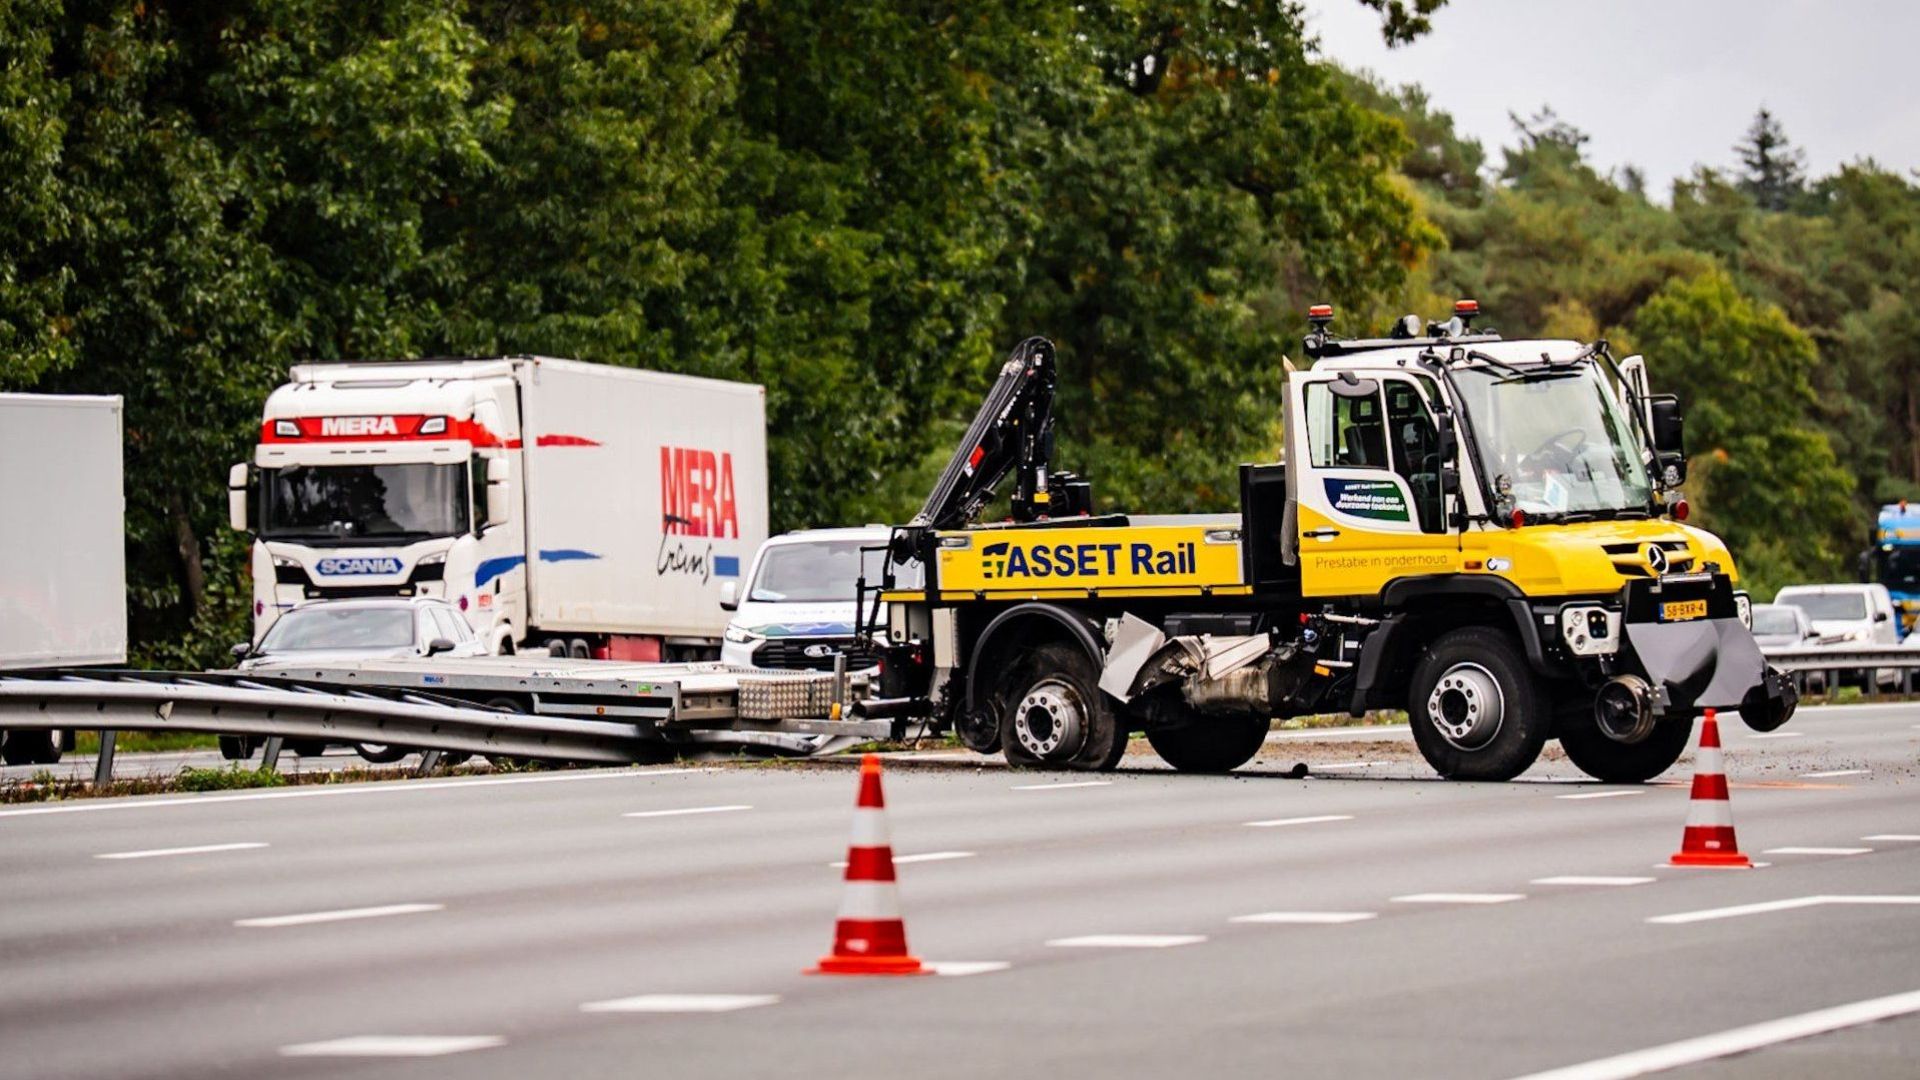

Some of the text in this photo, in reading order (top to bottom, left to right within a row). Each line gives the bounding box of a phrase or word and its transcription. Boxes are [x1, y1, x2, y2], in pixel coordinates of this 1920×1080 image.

[321, 416, 398, 437] MERA
[660, 446, 738, 539] MERA
[321, 559, 398, 574] SCANIA
[1006, 542, 1196, 577] ASSET Rail
[1315, 554, 1448, 569] Prestatie in onderhoud
